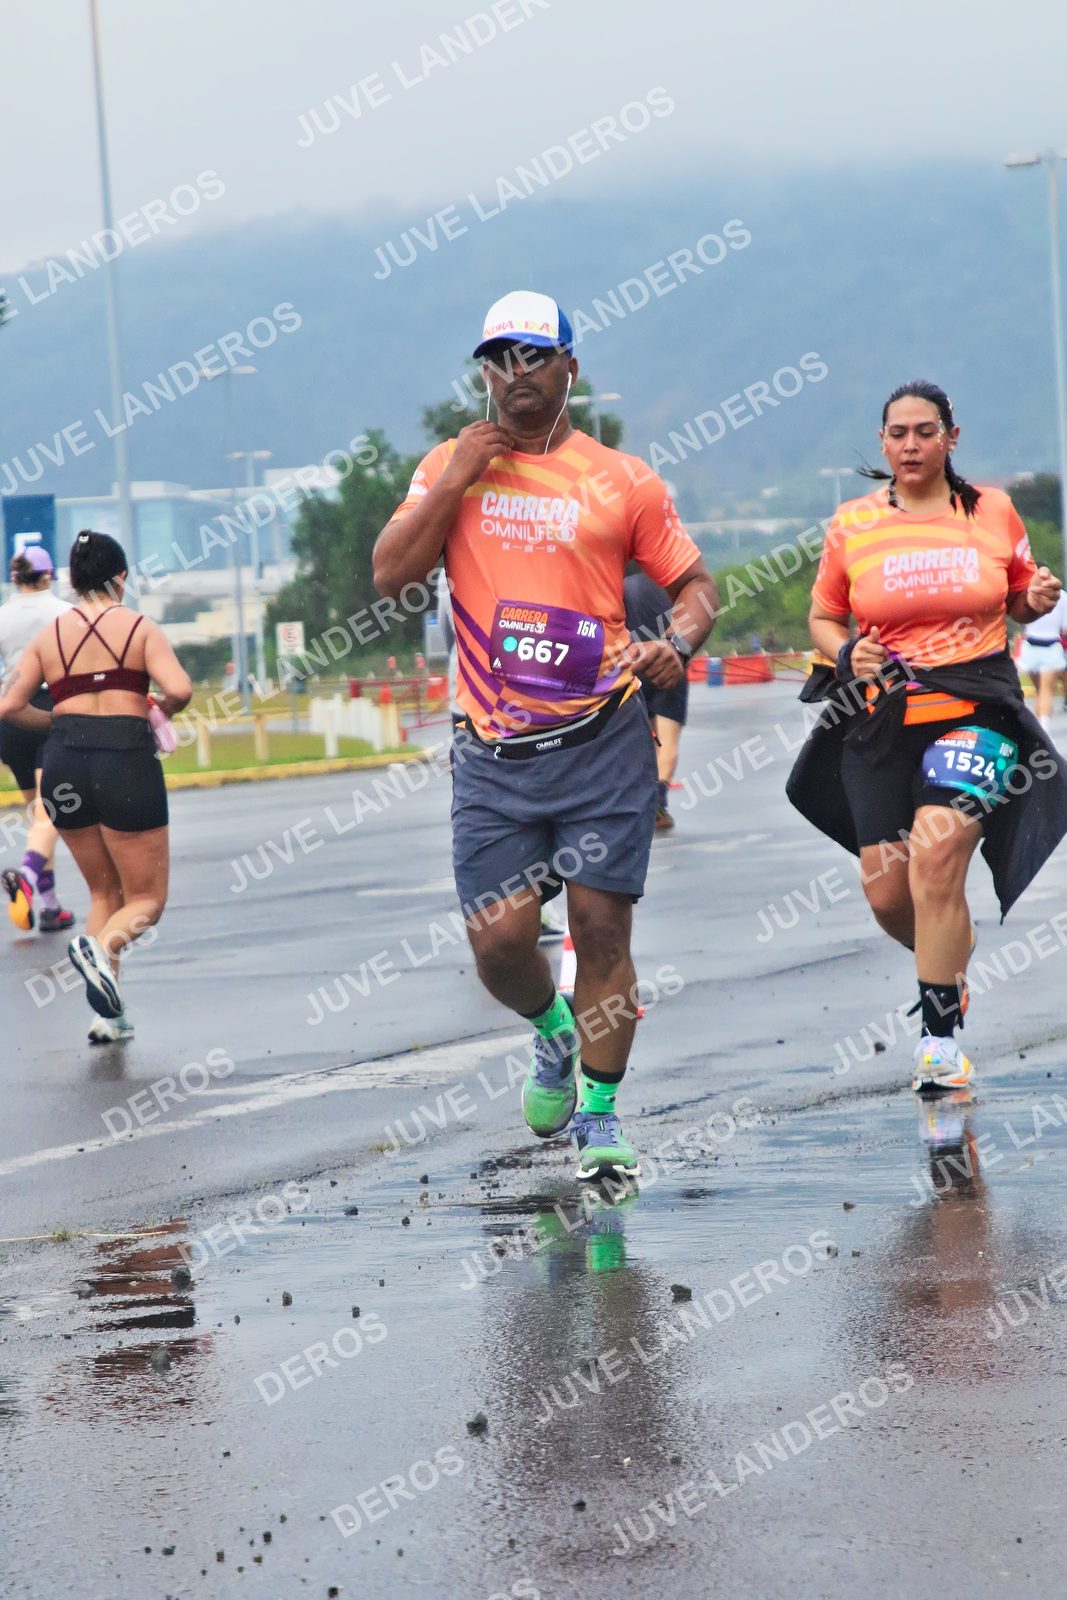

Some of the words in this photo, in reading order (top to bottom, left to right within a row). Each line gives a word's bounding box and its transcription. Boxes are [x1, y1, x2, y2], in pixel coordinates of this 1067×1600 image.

[481, 491, 579, 524] CARRERA
[481, 519, 553, 541] OMNILIFE
[883, 547, 979, 576] CARRERA
[884, 569, 960, 591] OMNILIFE
[499, 620, 535, 633] OMNILIFE
[501, 607, 548, 623] CARRERA
[518, 637, 569, 666] 667
[944, 751, 995, 780] 1524
